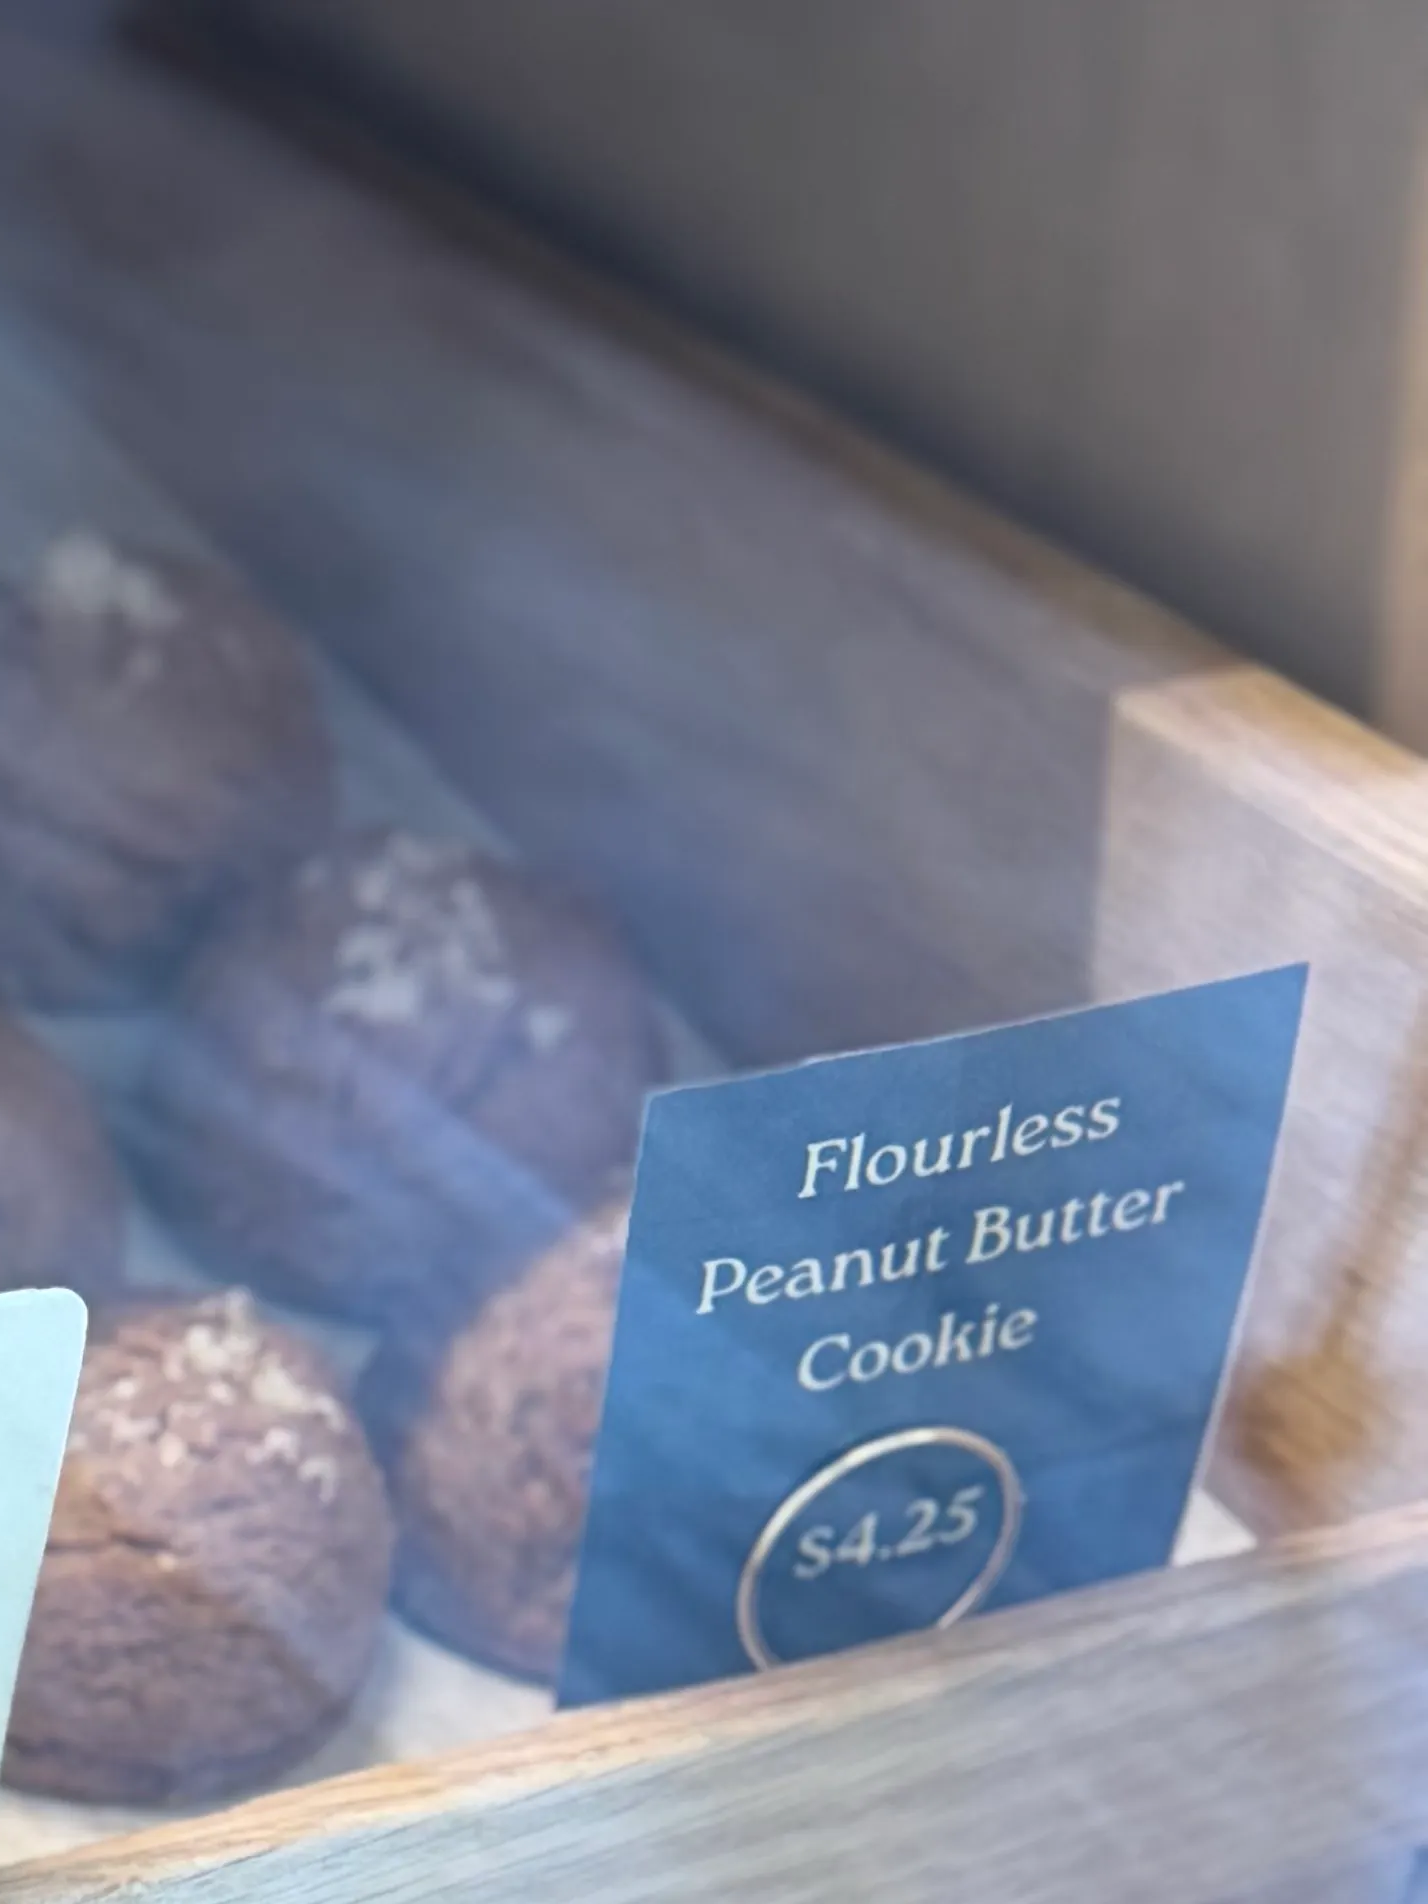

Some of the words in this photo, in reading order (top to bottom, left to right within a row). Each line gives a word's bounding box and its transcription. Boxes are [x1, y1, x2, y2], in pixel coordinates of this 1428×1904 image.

[798, 1097, 1121, 1199] Flourless
[695, 1227, 947, 1316] Peanut
[965, 1180, 1186, 1264] Butter
[797, 1302, 1038, 1393] Cookie
[792, 1486, 985, 1578] $4.25
